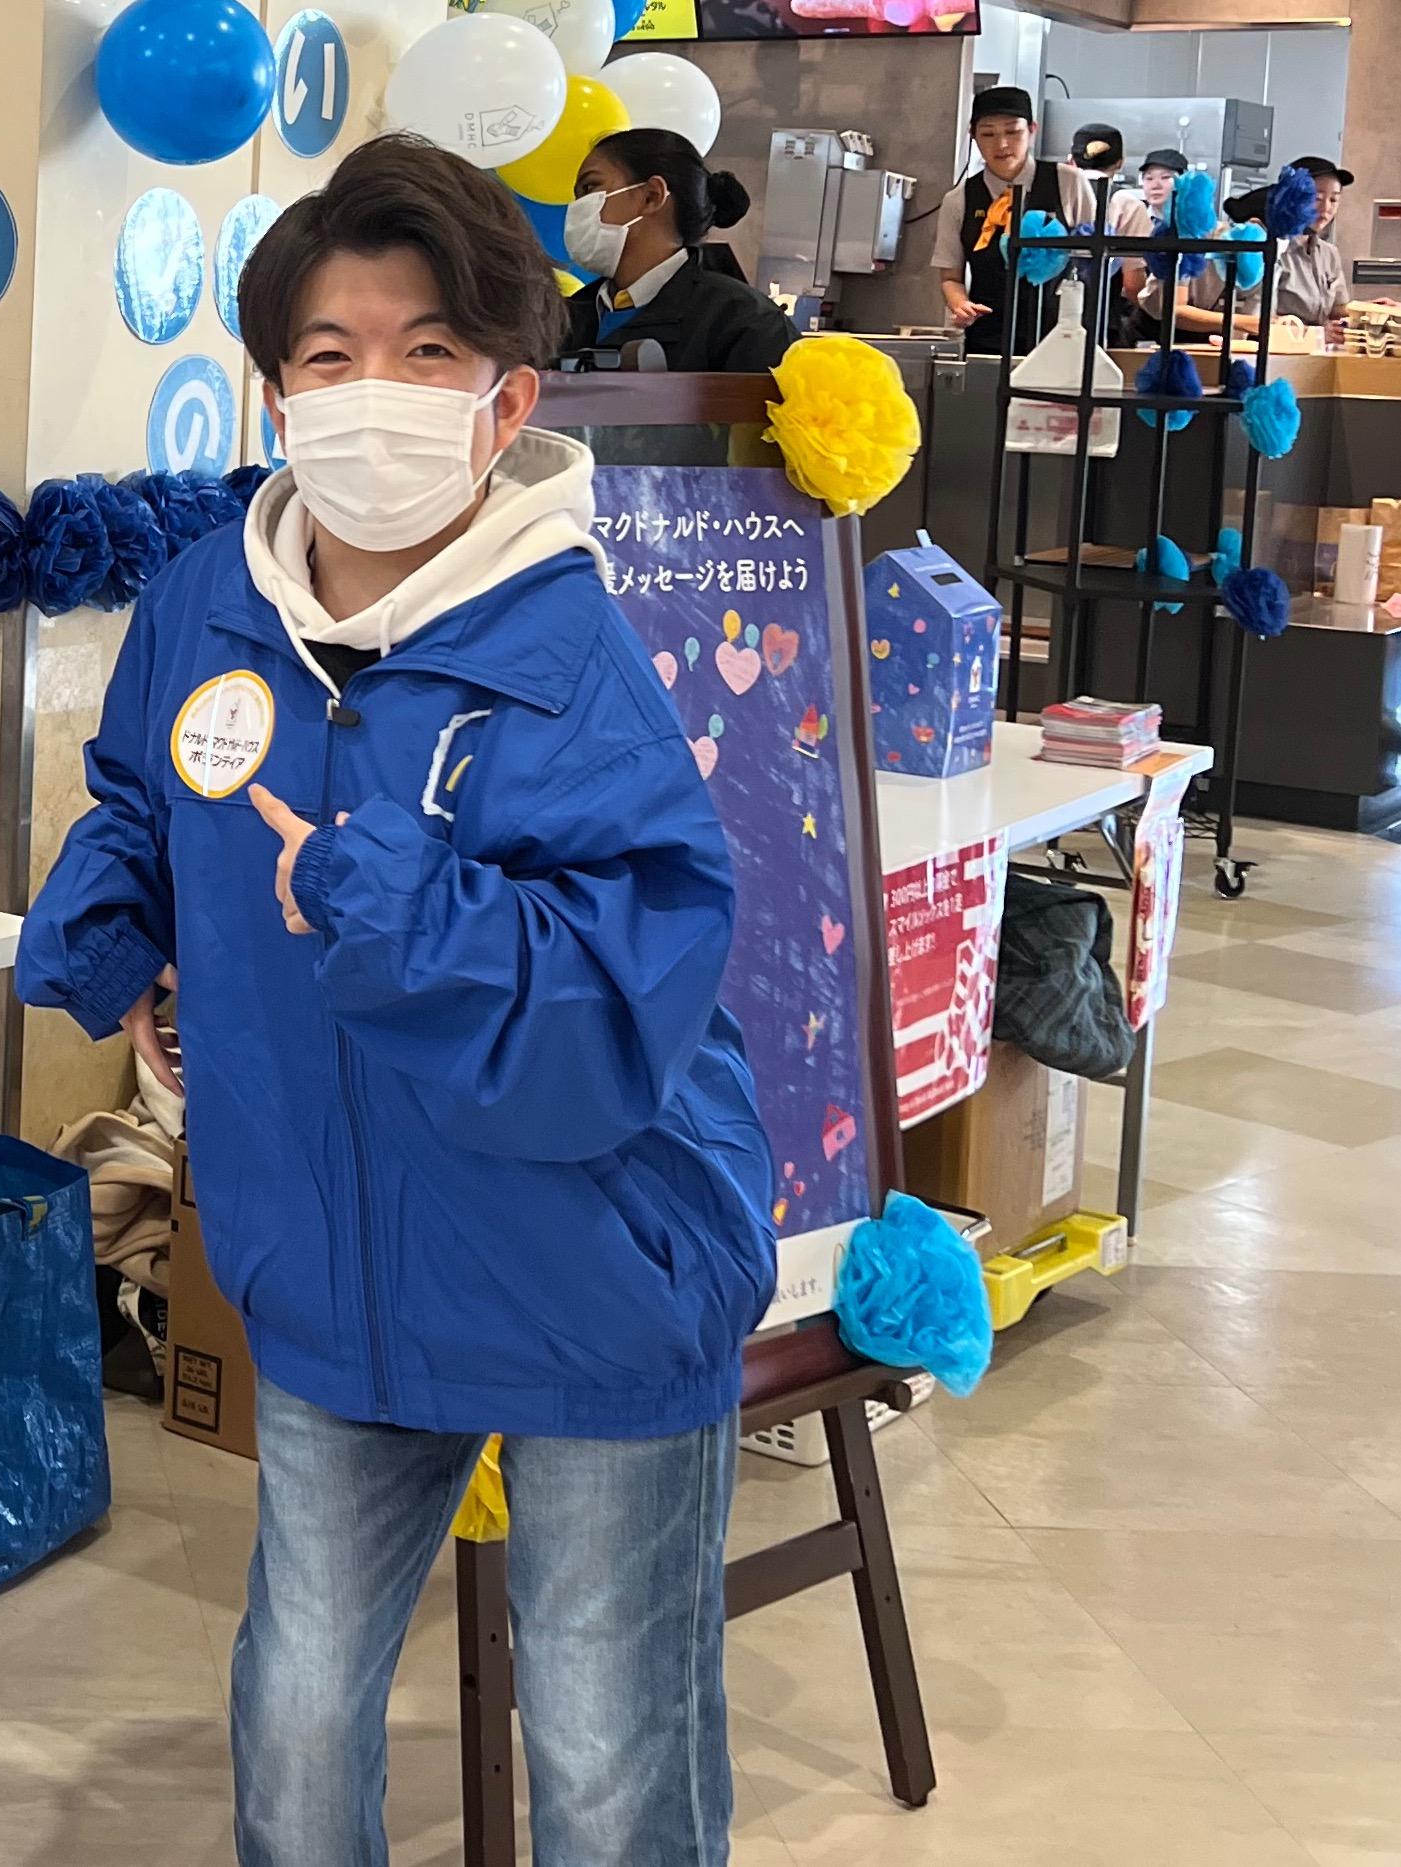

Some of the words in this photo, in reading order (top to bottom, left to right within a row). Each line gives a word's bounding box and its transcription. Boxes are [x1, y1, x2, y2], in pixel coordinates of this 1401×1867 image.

[284, 31, 336, 121] い
[593, 510, 805, 542] マクドナルド・ハウスへ
